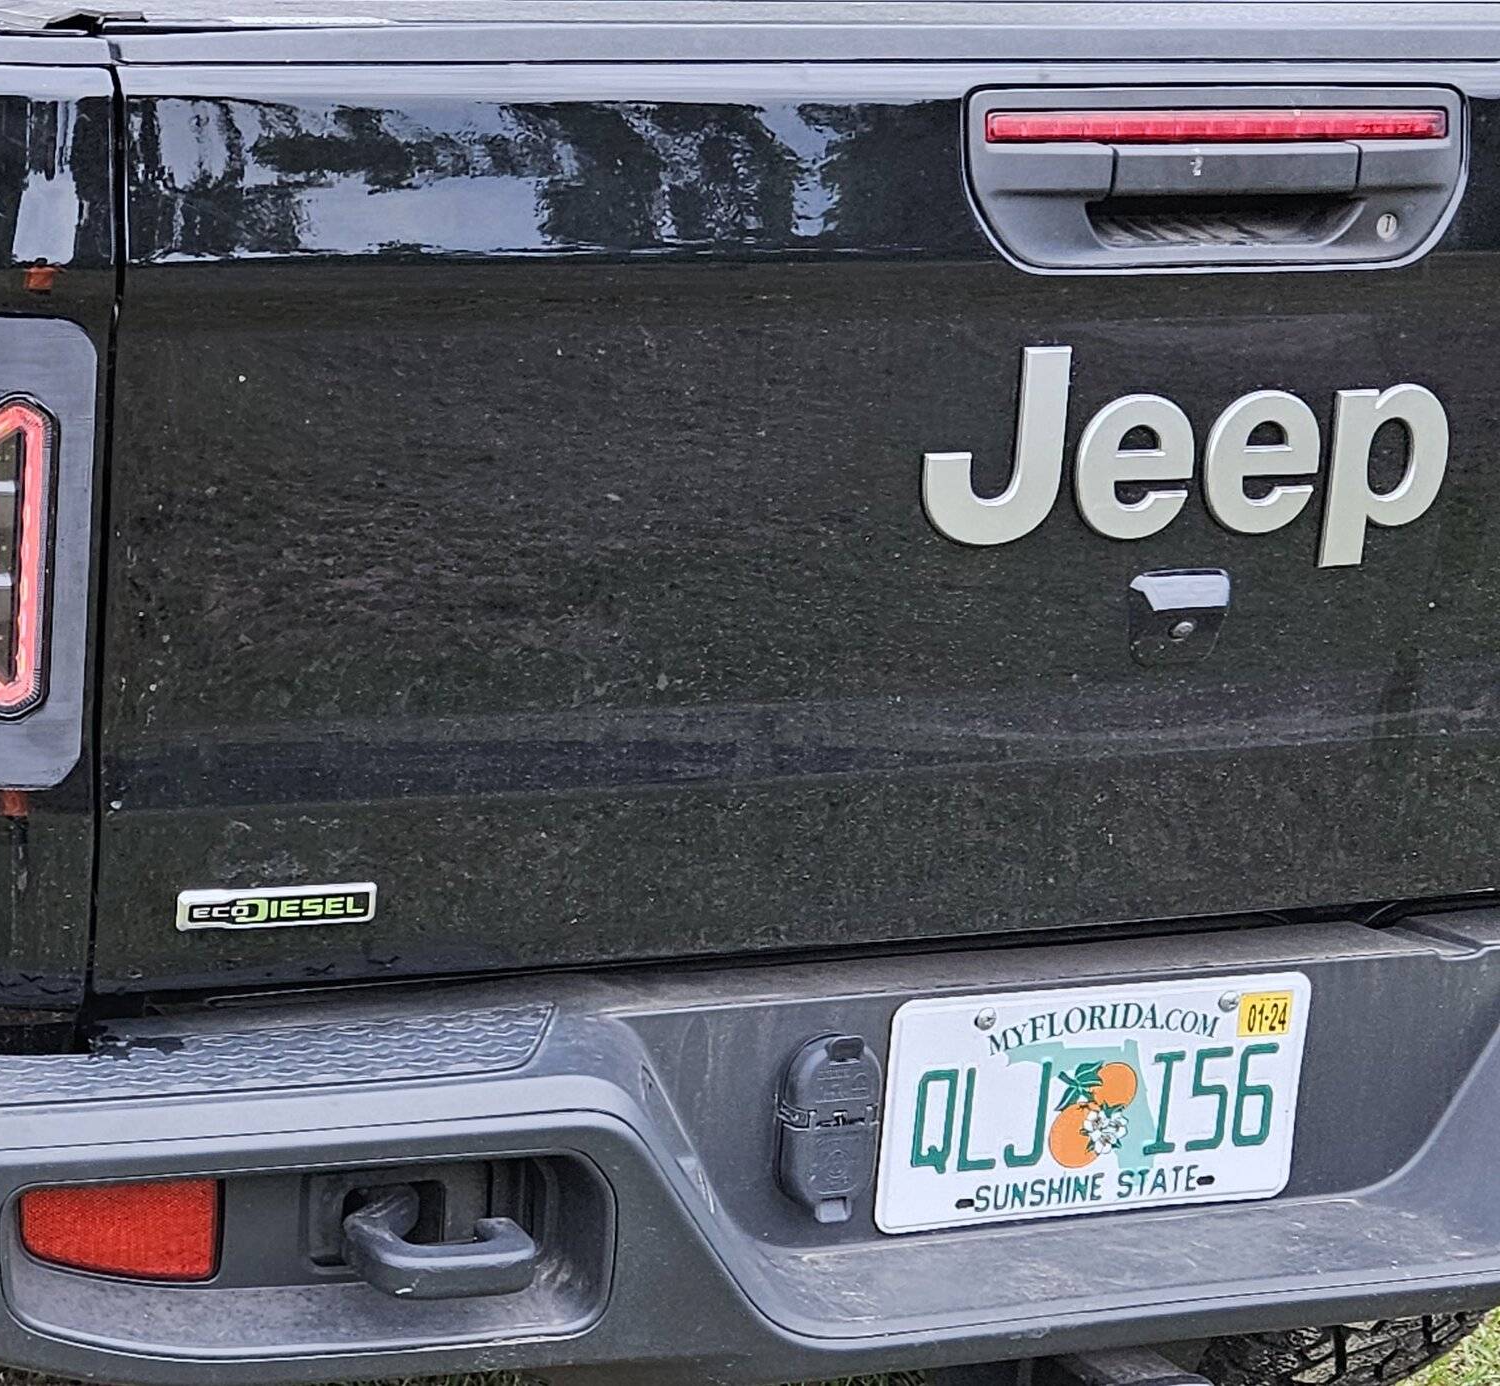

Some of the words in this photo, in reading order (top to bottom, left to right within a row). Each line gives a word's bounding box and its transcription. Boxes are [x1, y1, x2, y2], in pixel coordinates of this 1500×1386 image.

[921, 345, 1449, 568] Jeep
[989, 1003, 1220, 1056] MYFLORIDA.COM
[911, 1061, 1052, 1173] QLJ
[1144, 1043, 1280, 1155] I56
[974, 1173, 1105, 1212] SUNSHINE
[1118, 1165, 1199, 1199] STATE
